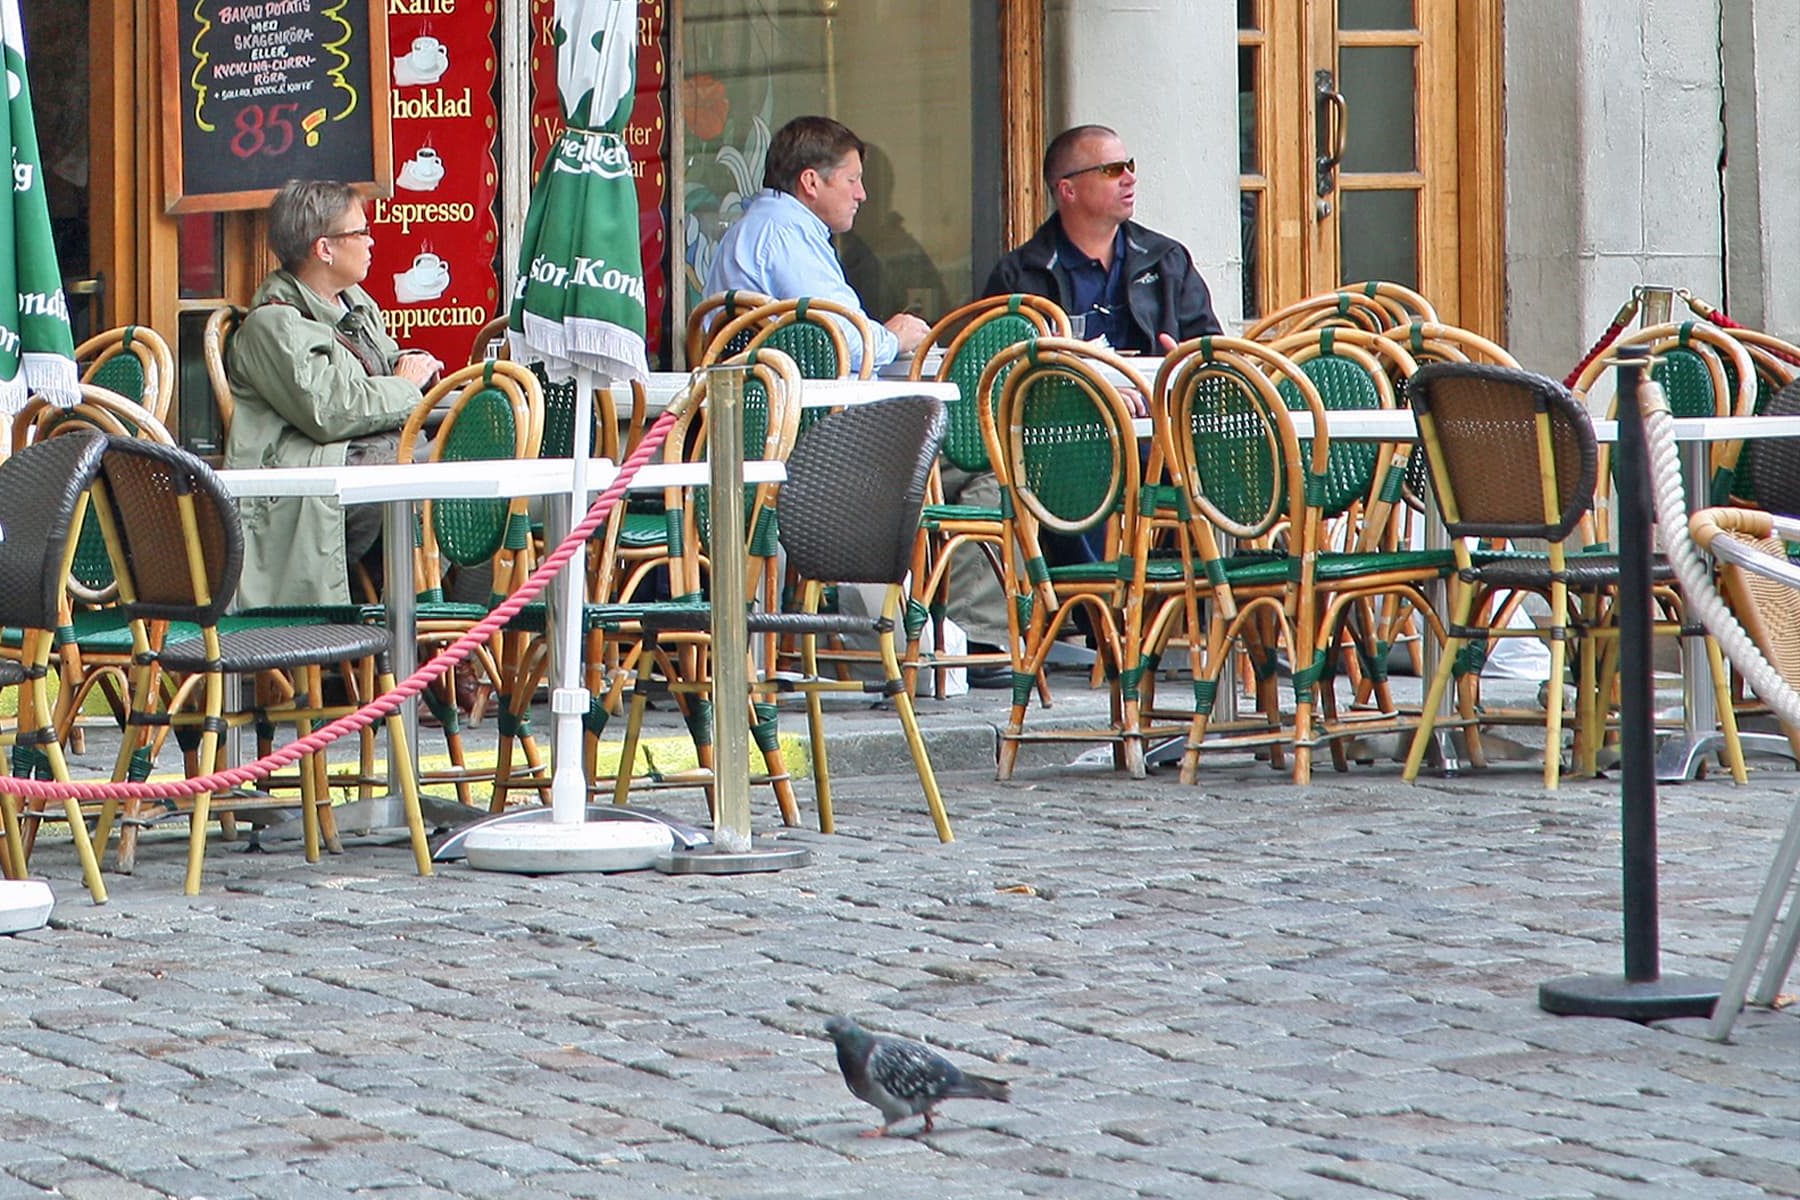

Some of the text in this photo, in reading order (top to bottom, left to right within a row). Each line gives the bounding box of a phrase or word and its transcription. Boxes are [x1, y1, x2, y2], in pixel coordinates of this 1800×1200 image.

[250, 20, 279, 35] MED
[390, 88, 473, 120] hoklad
[373, 198, 475, 235] Espresso
[379, 298, 486, 340] appuccino
